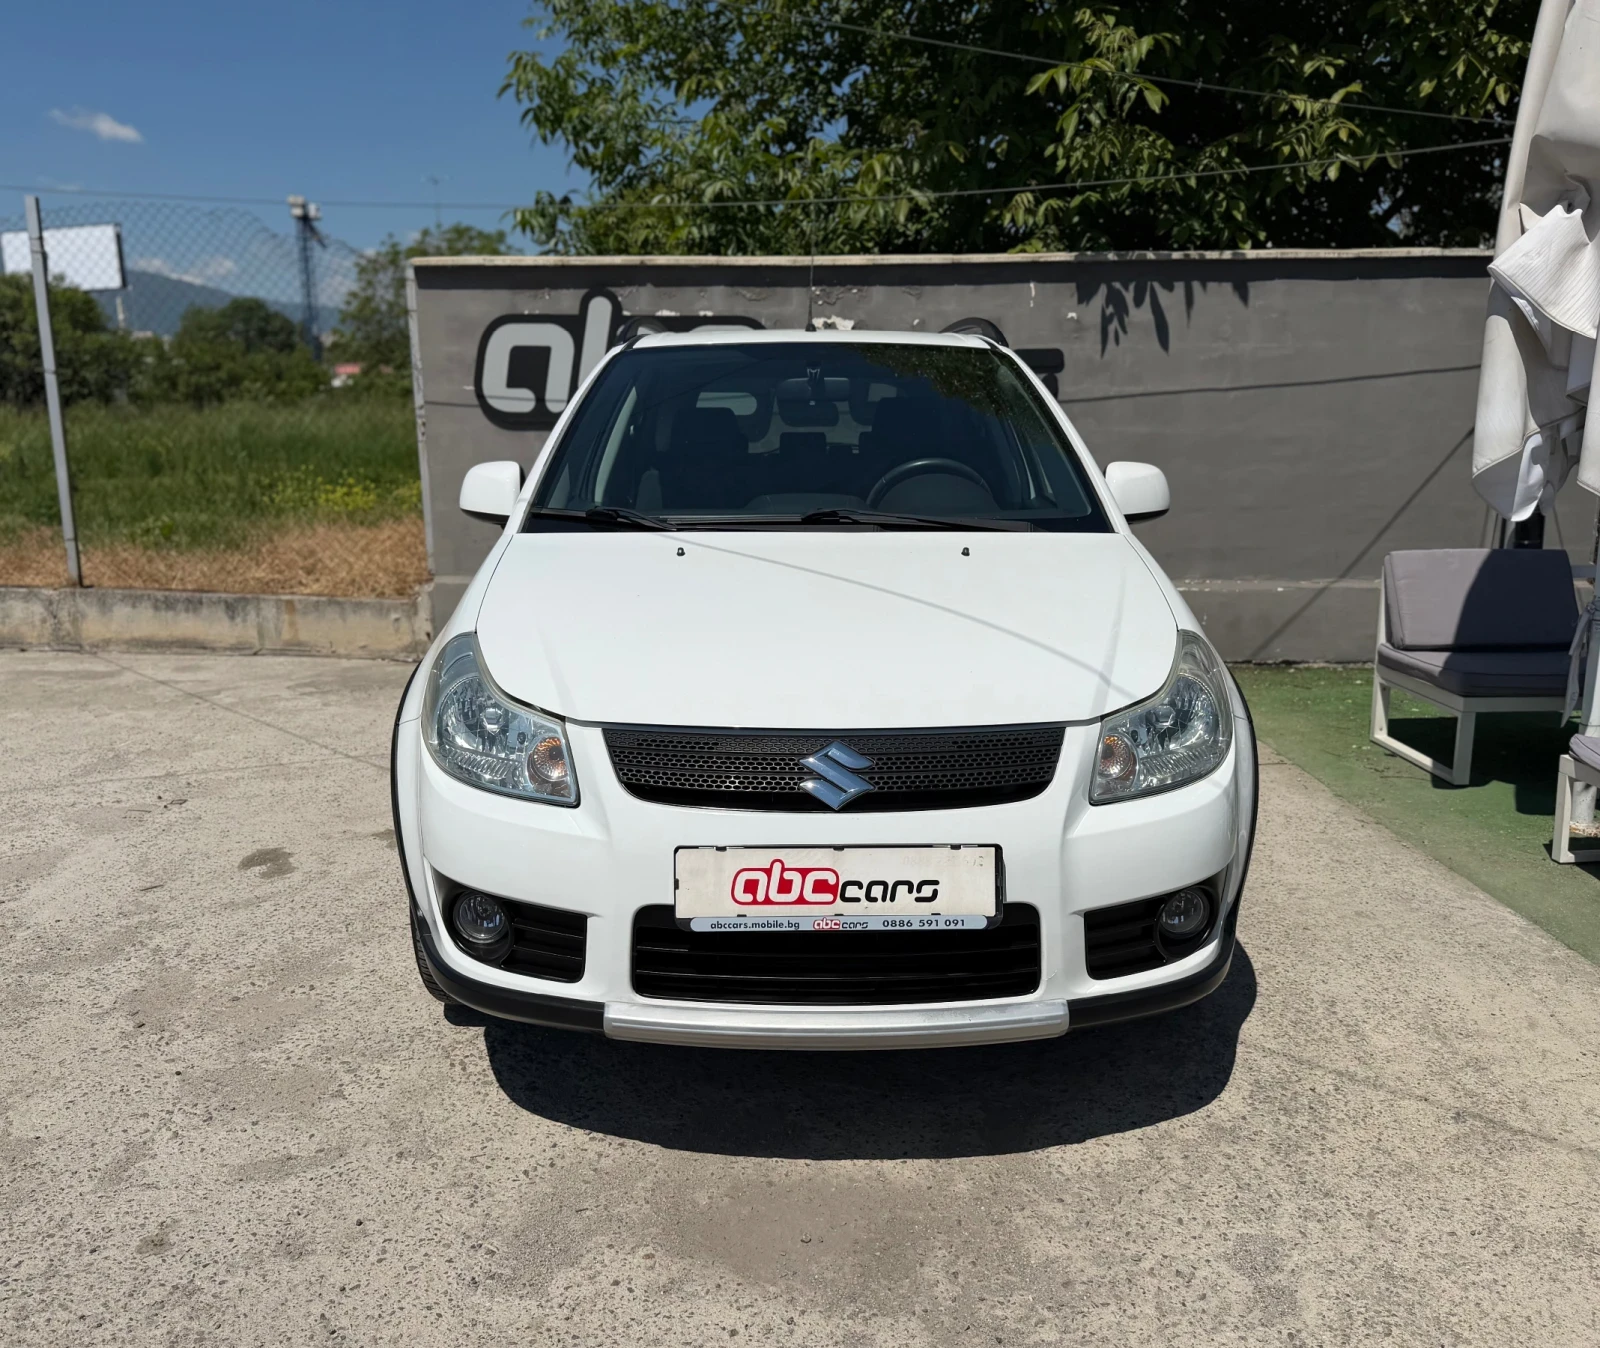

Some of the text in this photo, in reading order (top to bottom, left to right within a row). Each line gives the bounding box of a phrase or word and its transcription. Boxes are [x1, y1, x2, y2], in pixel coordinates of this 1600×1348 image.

[733, 859, 940, 904] abc cars
[710, 919, 800, 931] abccars.mobile.bg
[882, 919, 913, 928] 0886
[918, 919, 940, 928] 591
[944, 919, 966, 928] 091
